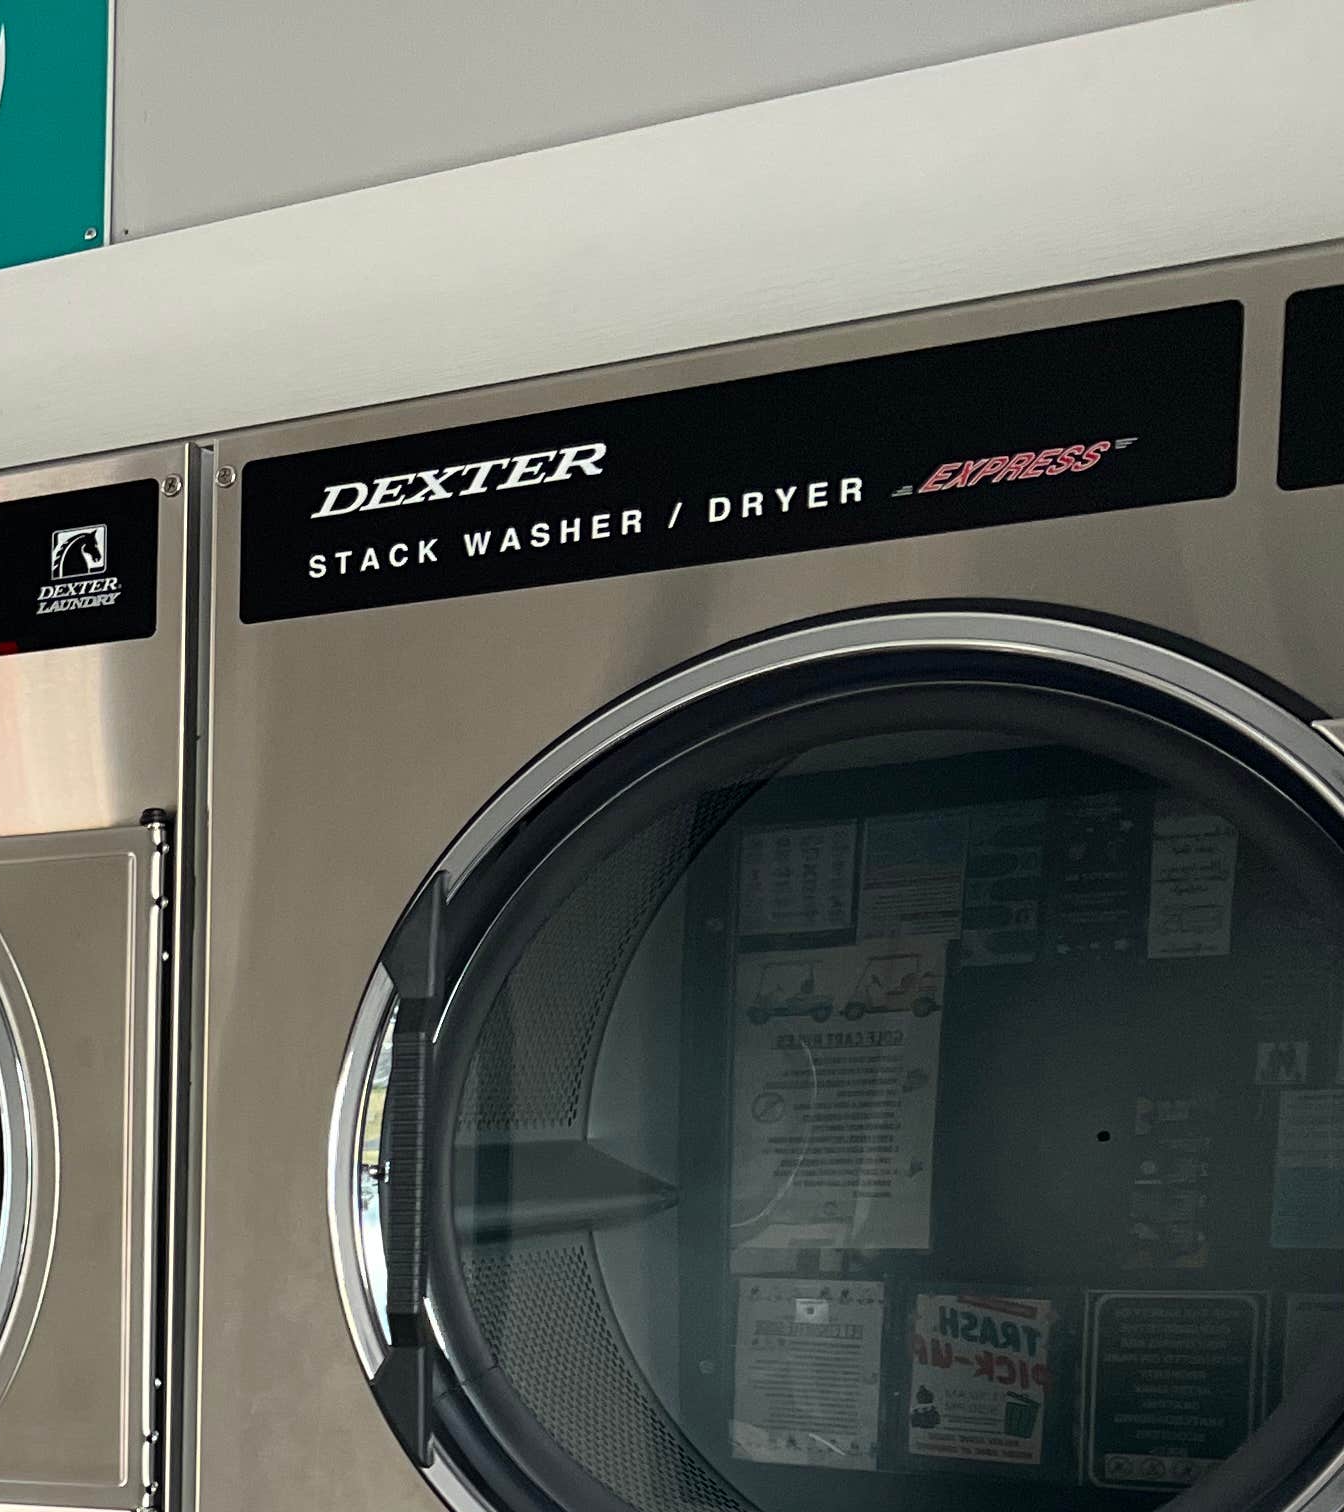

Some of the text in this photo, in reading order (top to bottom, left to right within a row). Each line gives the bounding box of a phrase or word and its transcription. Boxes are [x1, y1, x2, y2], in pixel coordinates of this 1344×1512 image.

[312, 442, 608, 520] DEXTER
[308, 538, 440, 580] STACK
[464, 509, 643, 558] WASHER
[708, 476, 864, 525] DRYER
[917, 440, 1112, 494] EXPRESS
[37, 591, 121, 615] LAUNDRY
[40, 577, 114, 601] DEXTER
